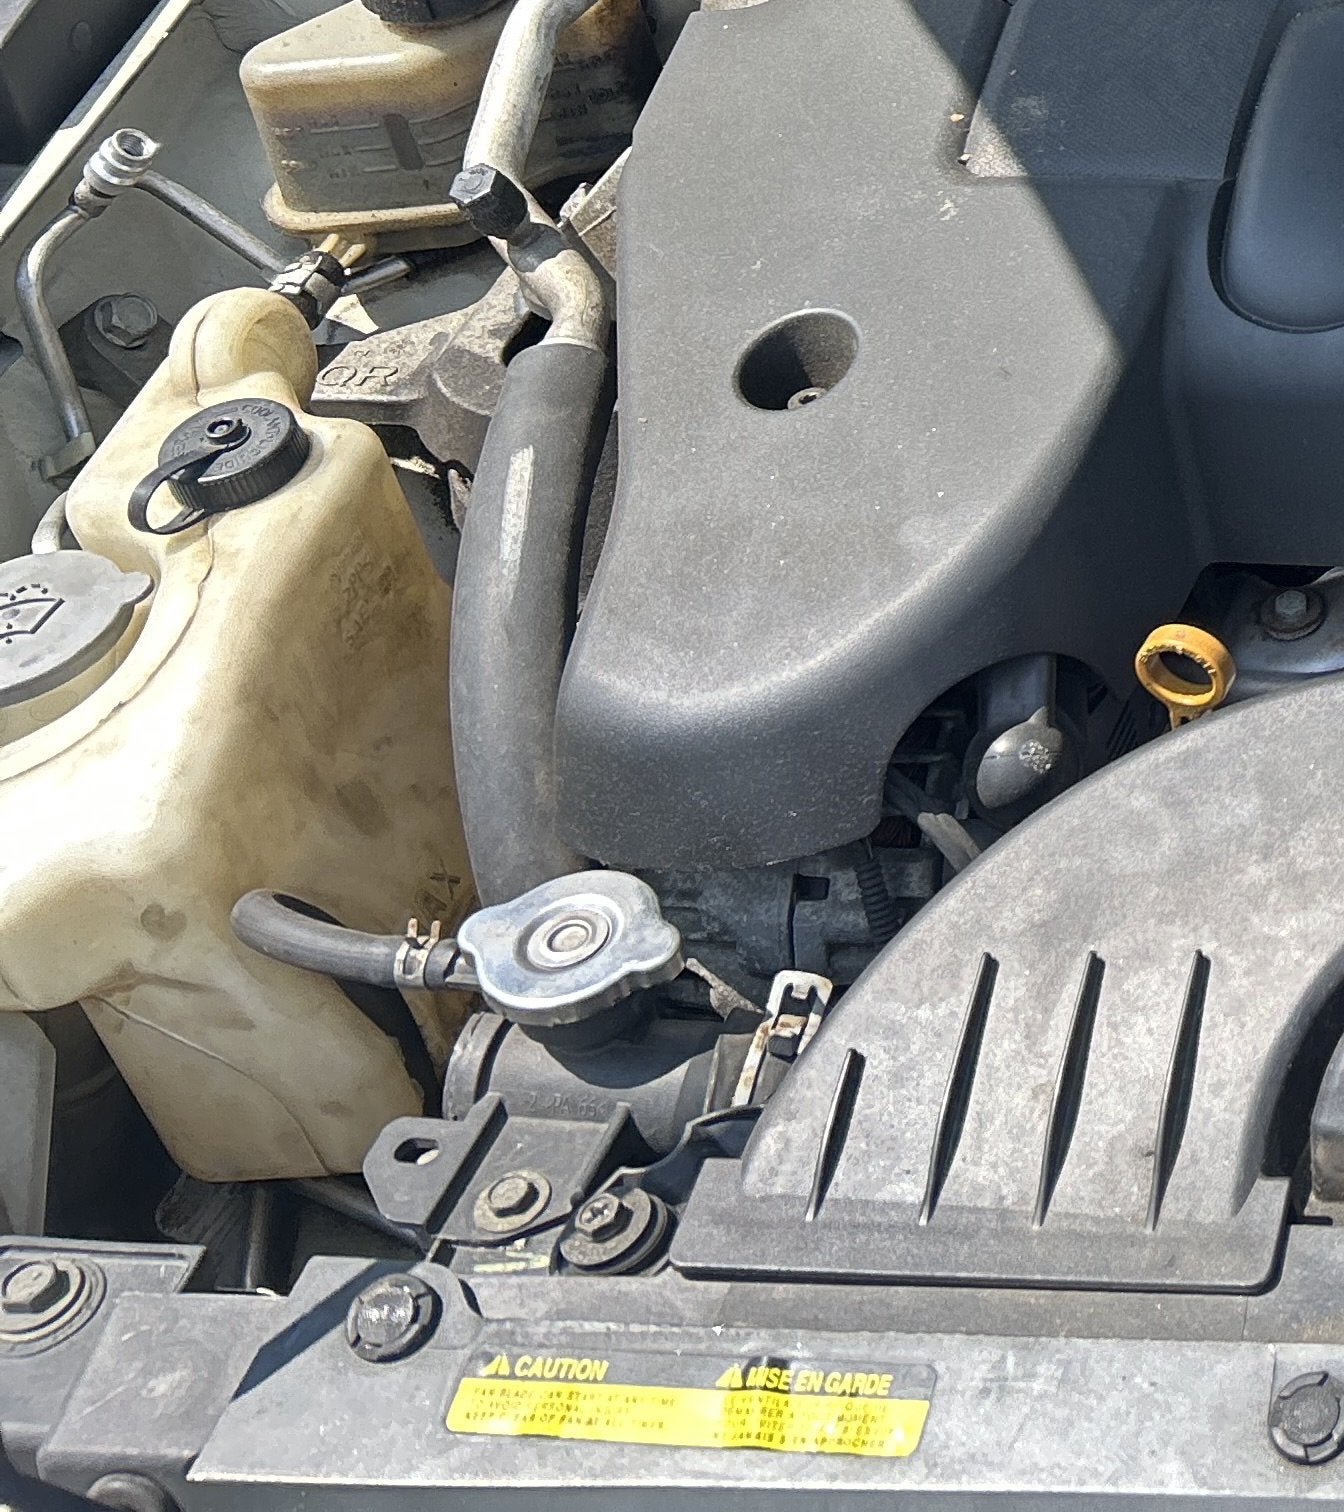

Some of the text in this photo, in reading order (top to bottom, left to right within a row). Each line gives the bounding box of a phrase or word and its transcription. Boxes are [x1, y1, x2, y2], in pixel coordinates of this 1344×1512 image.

[514, 1354, 609, 1381] CAUTION
[745, 1365, 894, 1395] MISE EN GARDE
